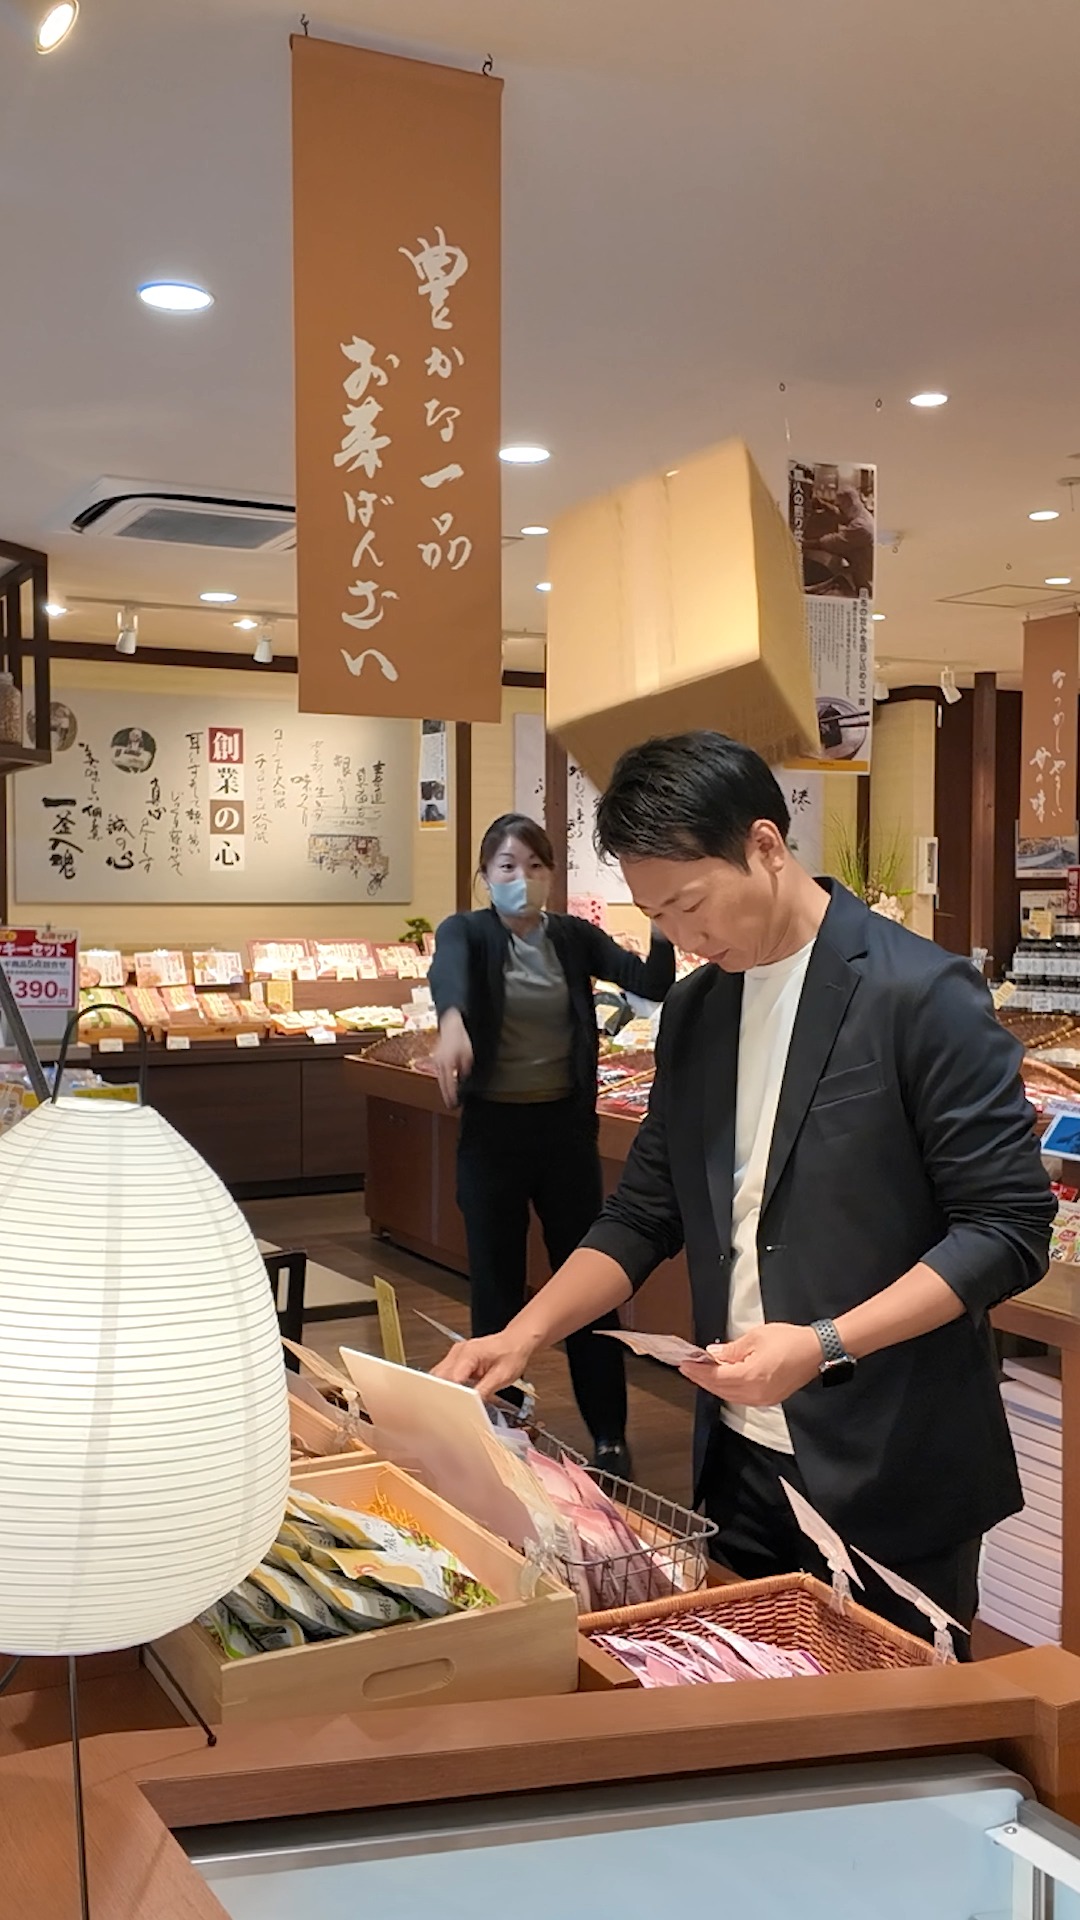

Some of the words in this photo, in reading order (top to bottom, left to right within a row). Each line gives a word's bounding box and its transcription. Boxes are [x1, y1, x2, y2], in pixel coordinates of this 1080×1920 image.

[398, 226, 472, 570] 豊かな一品
[334, 335, 400, 682] お菜ばんざい
[42, 796, 83, 880] 一釜入魂
[106, 814, 135, 871] 誠の心
[211, 730, 243, 868] 創業の心
[10, 977, 69, 999] 390円
